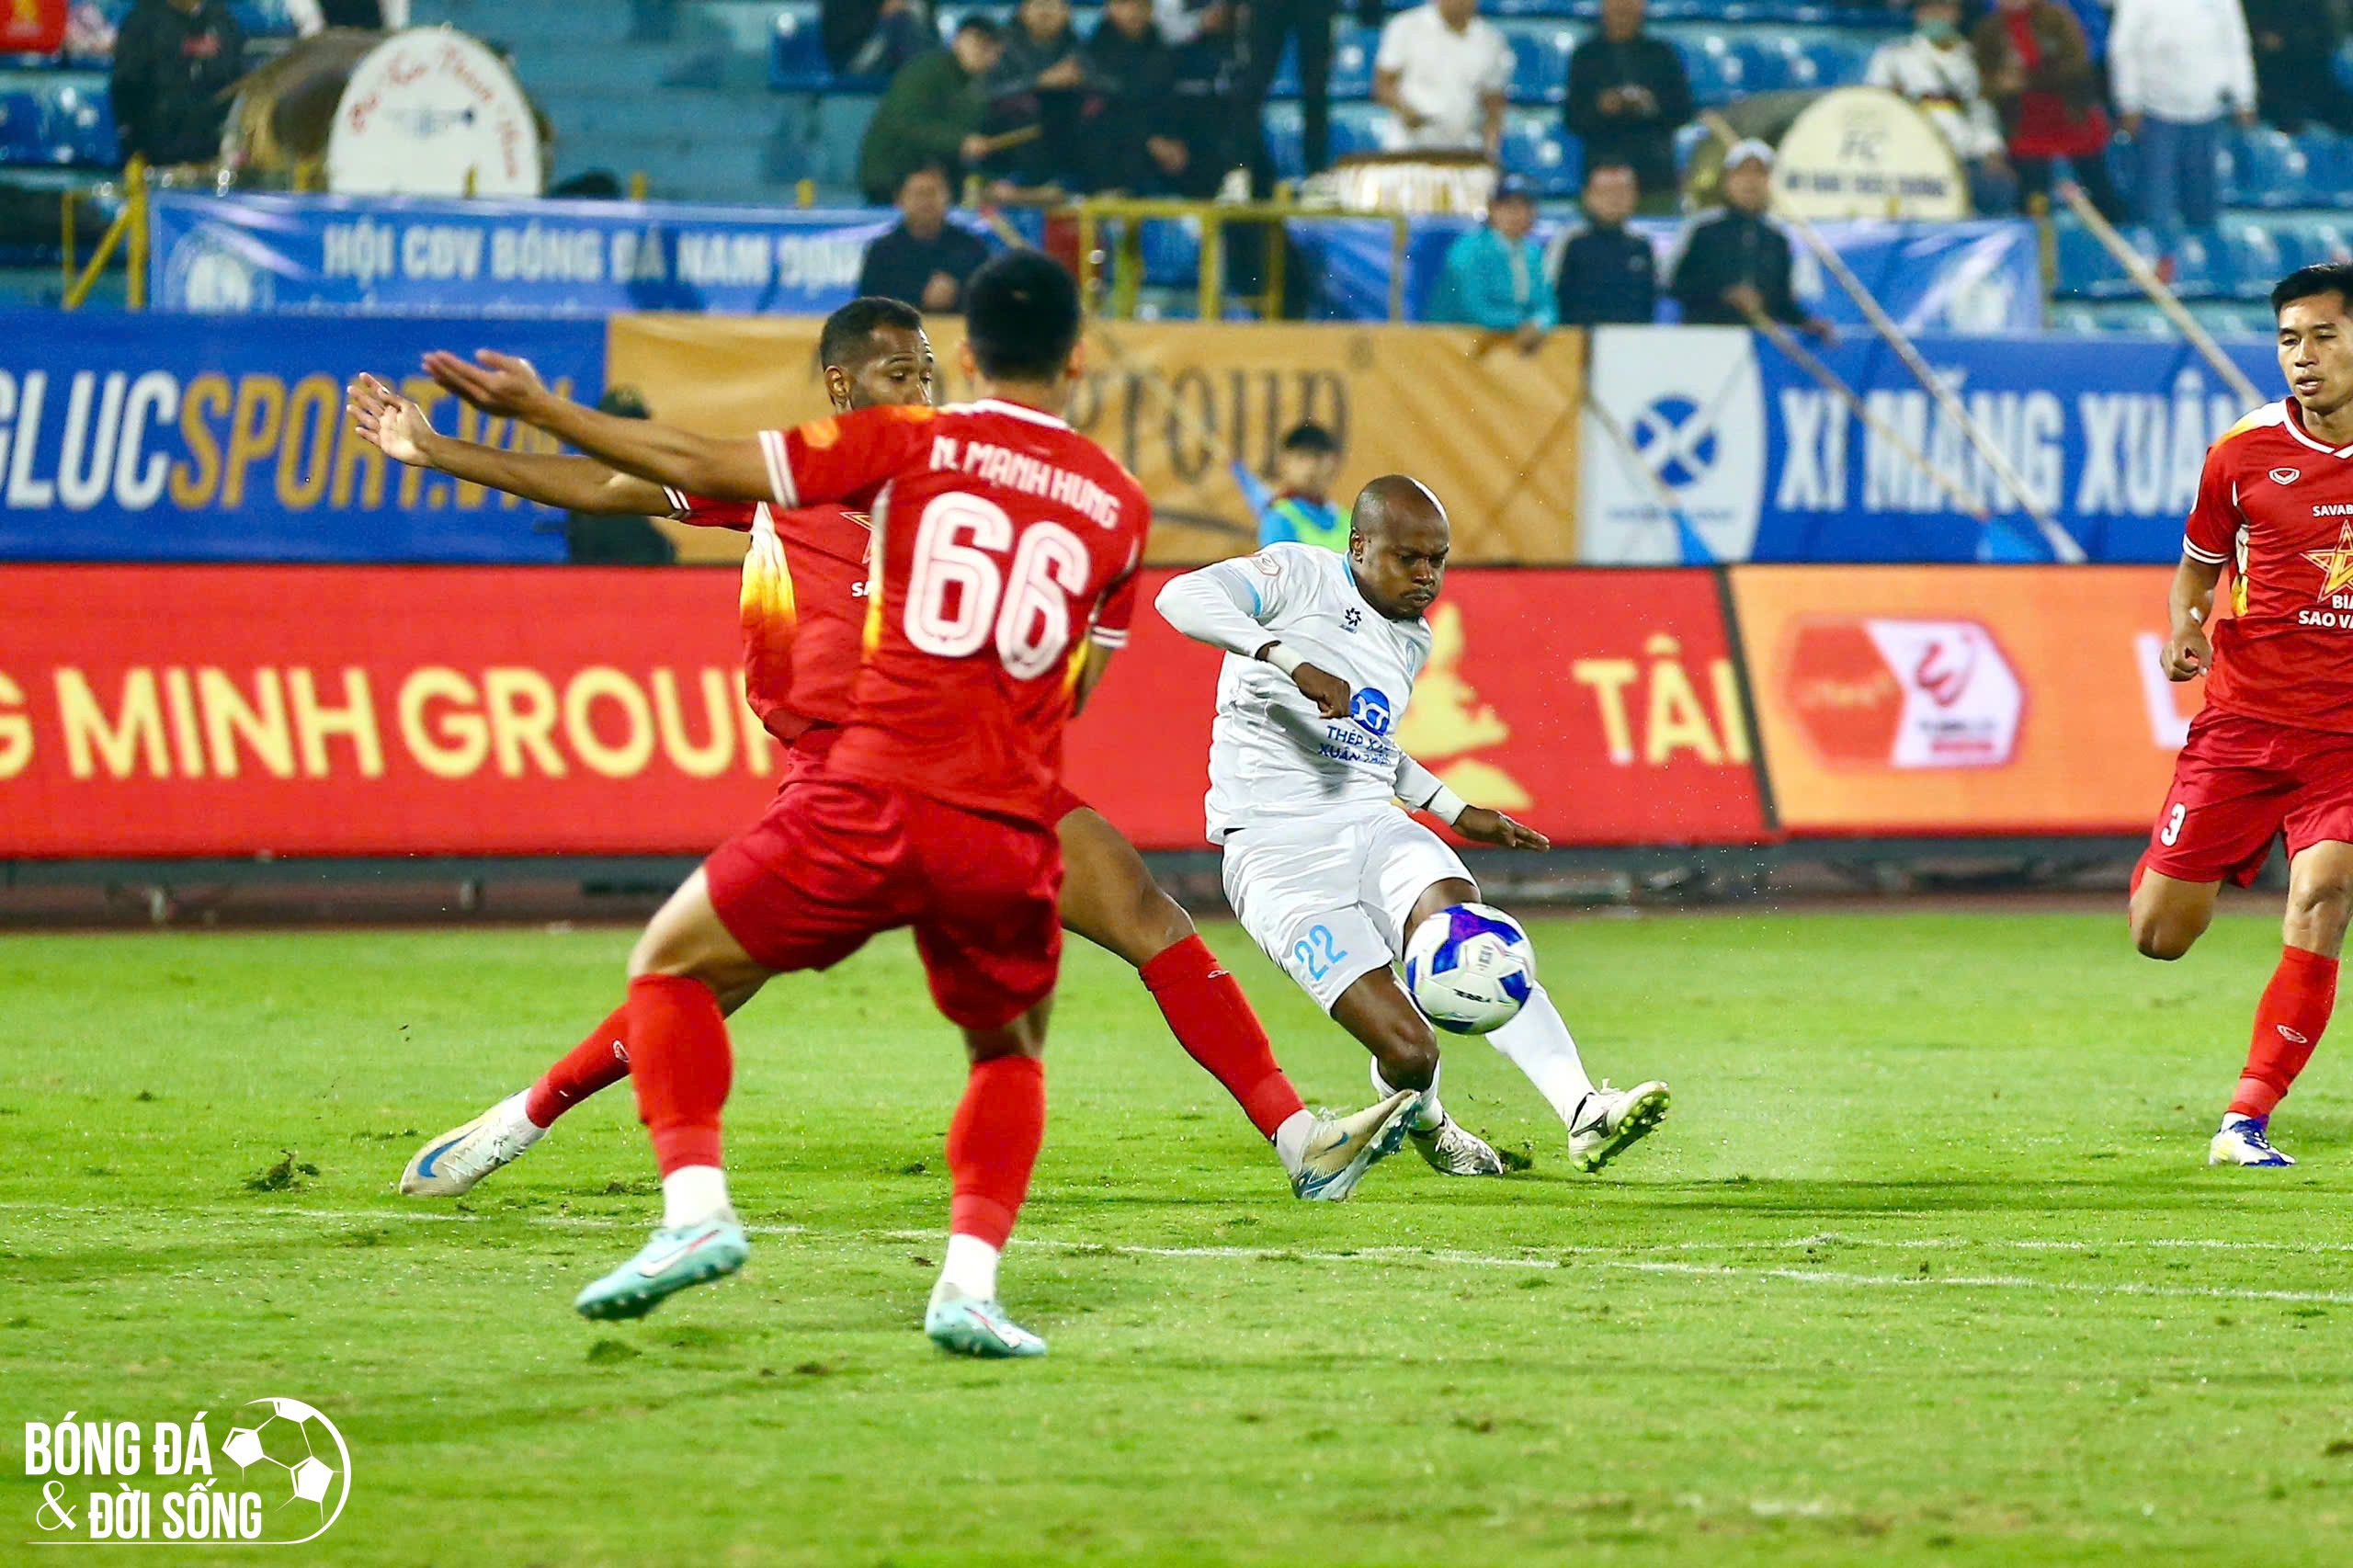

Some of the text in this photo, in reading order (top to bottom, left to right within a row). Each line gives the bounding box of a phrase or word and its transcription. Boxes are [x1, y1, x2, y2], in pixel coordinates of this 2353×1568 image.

[324, 216, 394, 290] HỘI
[490, 220, 603, 281] BÓNG
[676, 232, 771, 287] NAM
[928, 435, 958, 471] N.
[1776, 387, 1847, 511] XI
[1864, 366, 2065, 515] MĂNG
[903, 491, 1091, 681] 66
[2298, 610, 2336, 627] SAO
[53, 666, 385, 779] MINH
[1326, 724, 1363, 746] THÉP
[2161, 802, 2187, 847] 3
[1294, 925, 1347, 981] 22
